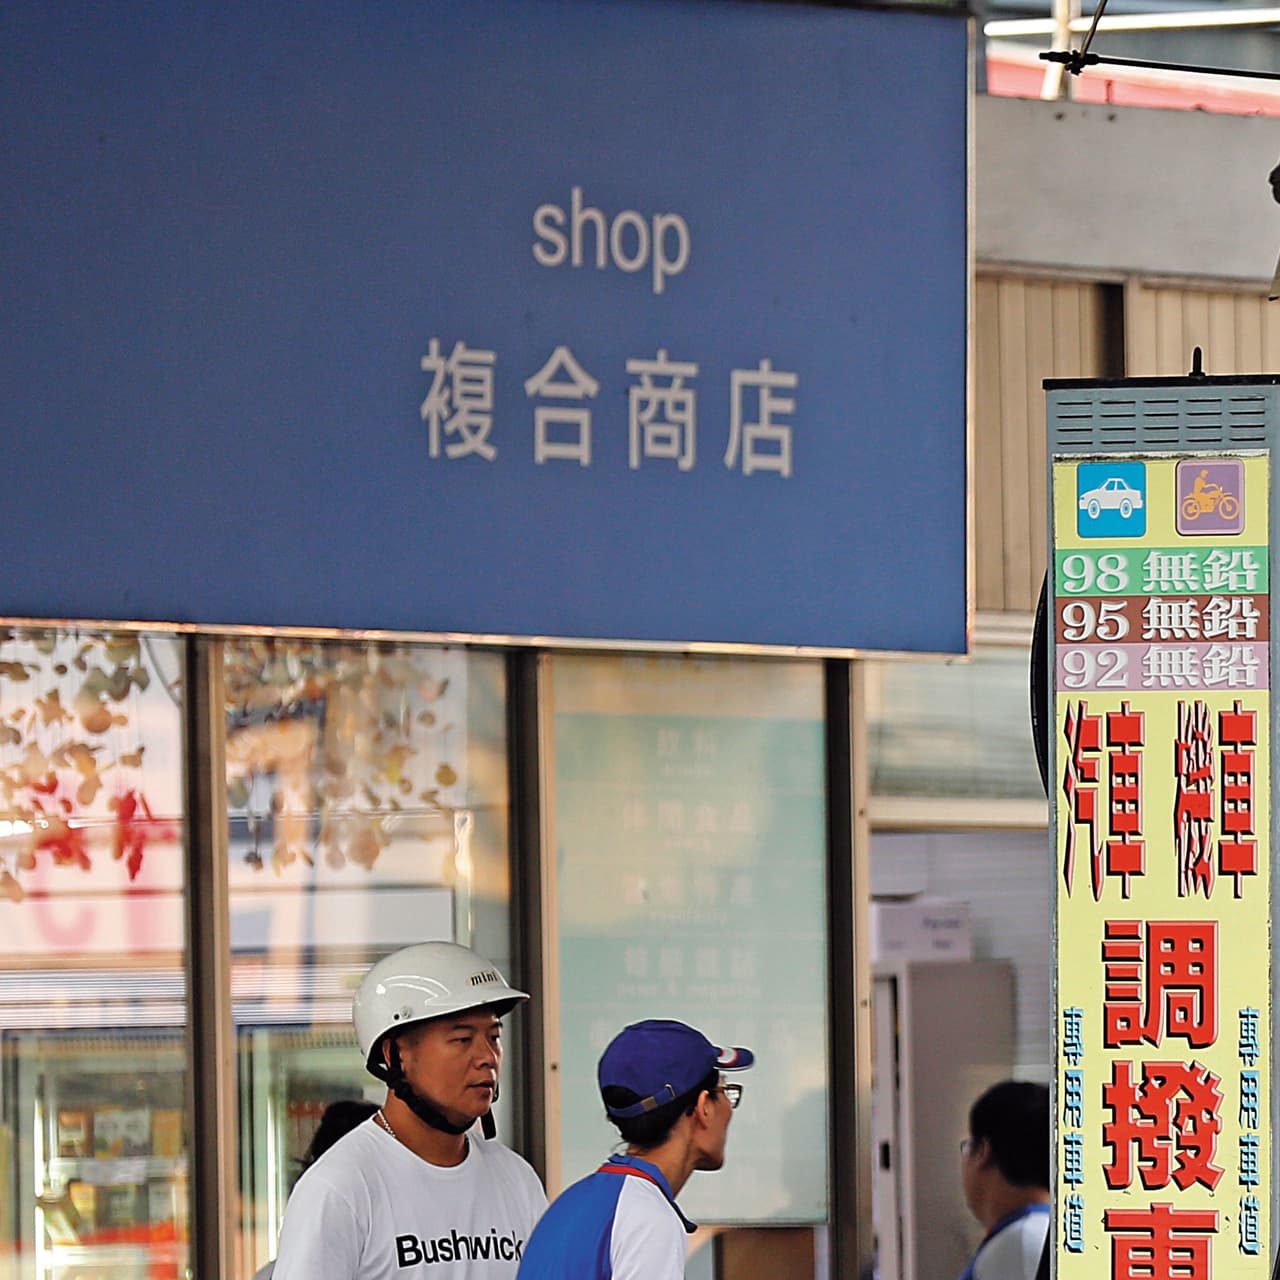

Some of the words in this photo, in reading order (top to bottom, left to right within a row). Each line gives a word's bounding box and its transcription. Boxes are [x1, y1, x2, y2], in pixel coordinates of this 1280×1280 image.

[531, 187, 691, 294] shop
[420, 338, 798, 478] 複合商店
[396, 1229, 522, 1268] Bushwick
